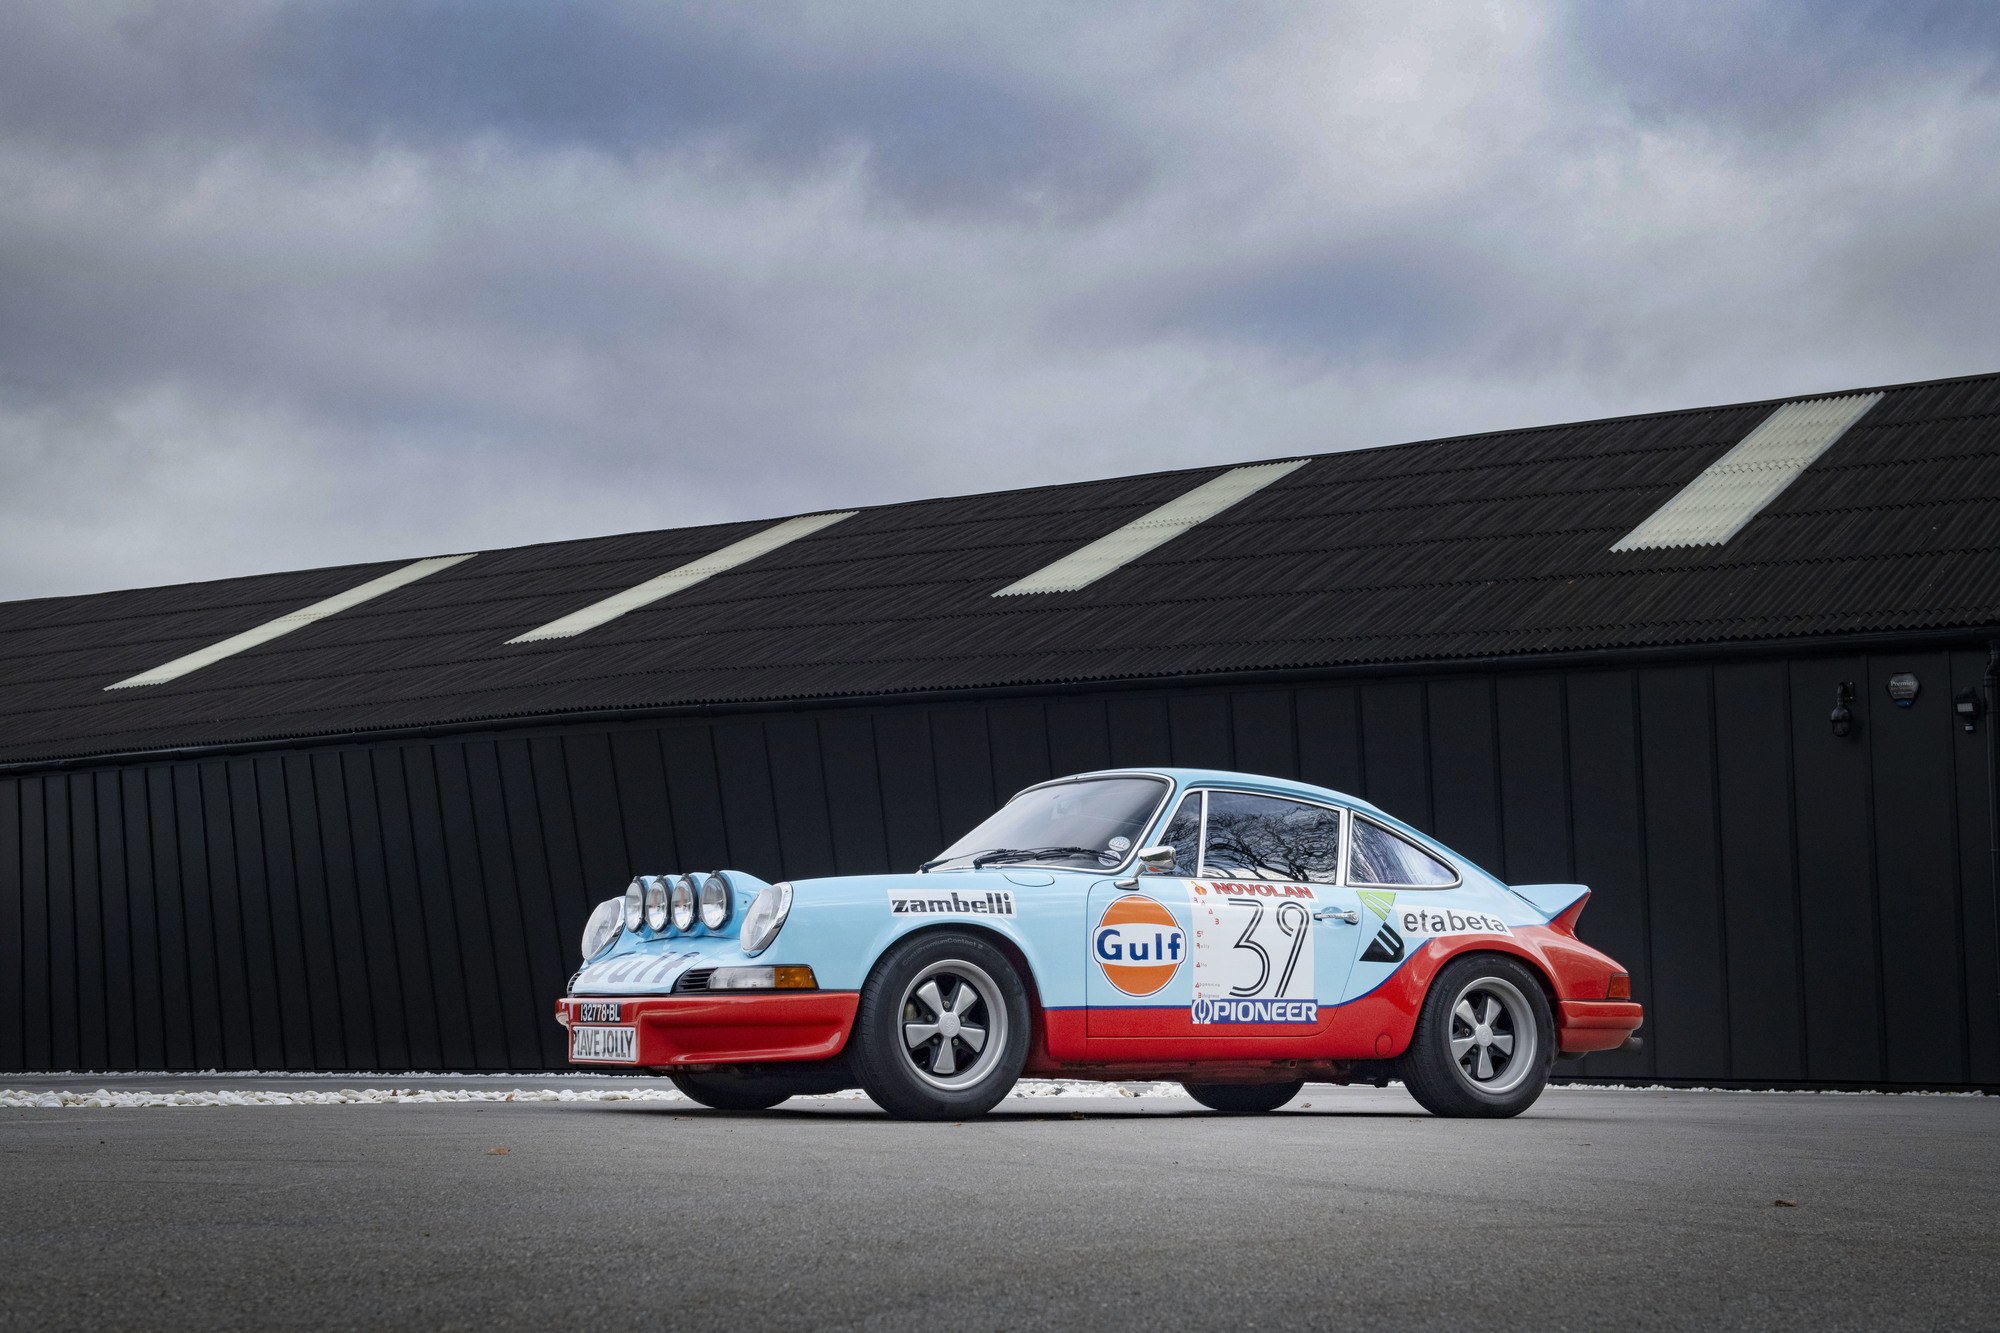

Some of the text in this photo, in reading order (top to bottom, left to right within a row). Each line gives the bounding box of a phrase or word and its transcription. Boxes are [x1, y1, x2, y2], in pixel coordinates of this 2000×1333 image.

[1211, 882, 1314, 899] NOVOLAN
[892, 892, 1012, 914] zambelli
[1403, 909, 1508, 933] etabeta
[1096, 929, 1182, 961] Gulf
[1228, 898, 1310, 998] 39
[1213, 1001, 1317, 1021] PIONEER
[602, 1030, 634, 1057] JOLLY
